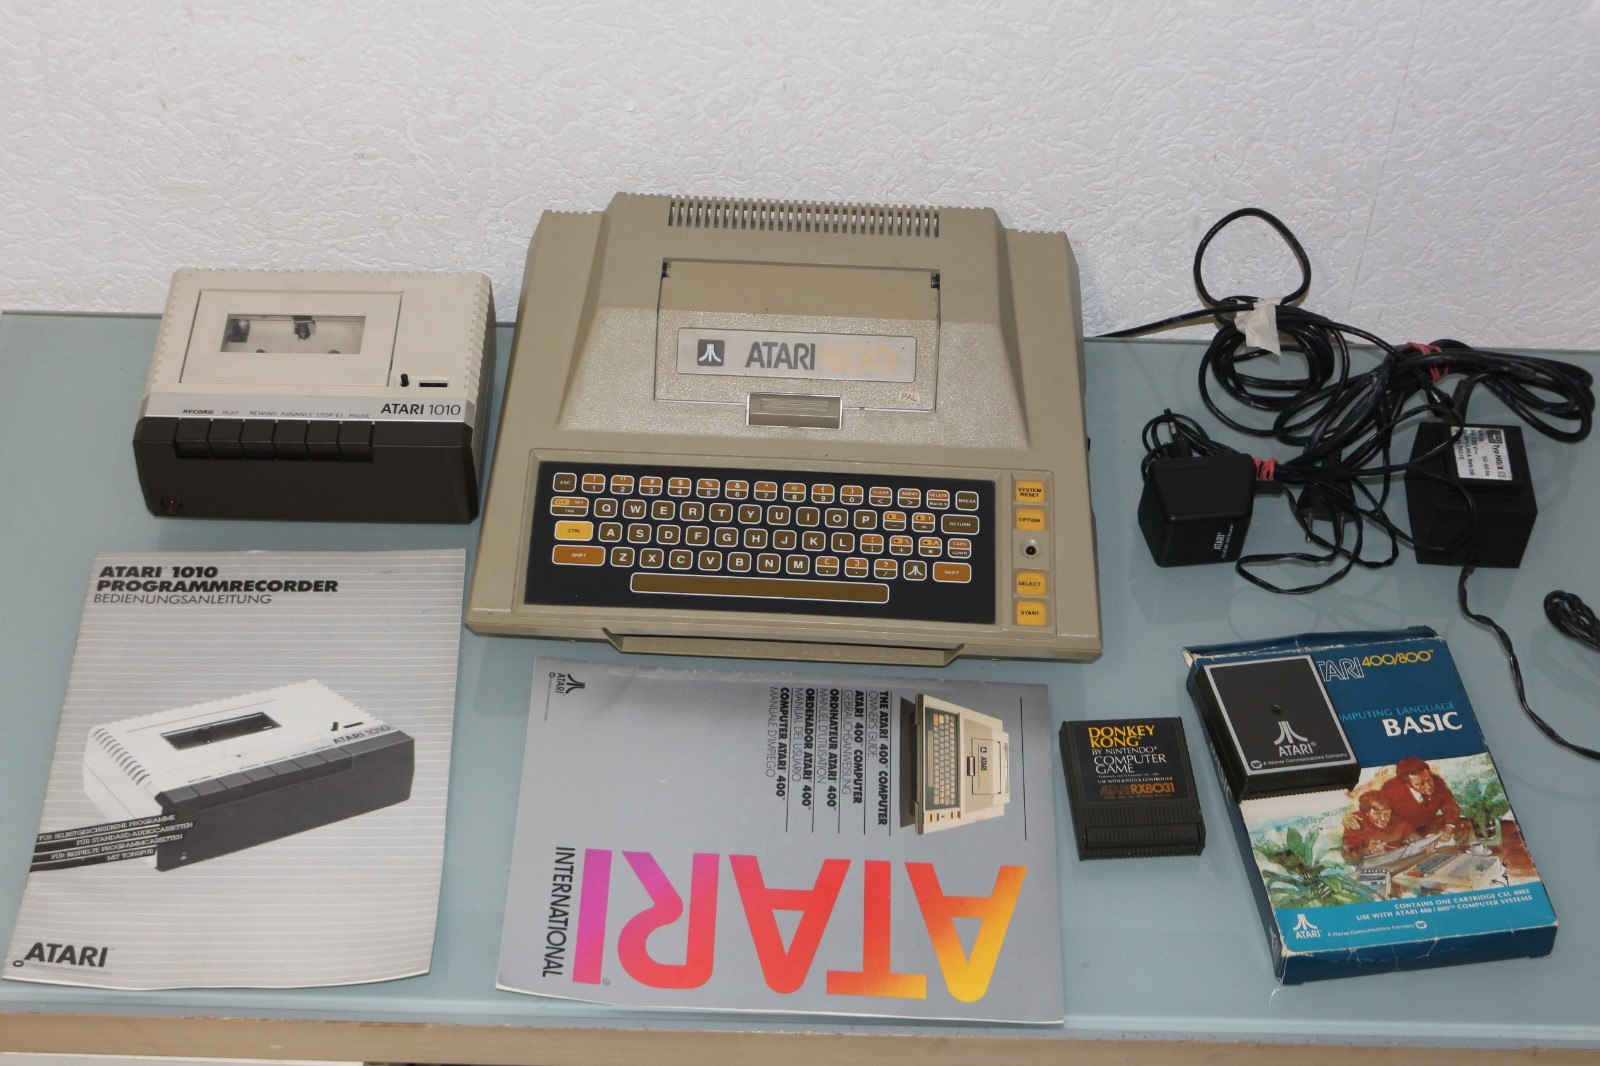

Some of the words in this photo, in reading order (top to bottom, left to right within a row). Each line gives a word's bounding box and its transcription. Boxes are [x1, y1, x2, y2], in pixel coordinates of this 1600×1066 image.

[745, 341, 816, 371] ATARI
[818, 342, 898, 374] 400
[901, 392, 918, 401] PAL
[381, 403, 425, 416] ATARI
[429, 404, 461, 416] 1010
[602, 504, 611, 513] Q
[630, 505, 642, 514] W
[660, 506, 668, 515] E
[688, 507, 697, 516] R
[718, 509, 726, 517] T
[747, 510, 755, 519] Y
[775, 511, 784, 520] U
[832, 514, 842, 523] O
[862, 515, 870, 524] P
[606, 528, 615, 537] A
[635, 529, 644, 538] S
[664, 530, 673, 540] D
[694, 531, 702, 540] F
[722, 533, 732, 542] G
[751, 534, 760, 543] H
[781, 536, 788, 545] J
[809, 537, 818, 546] K
[839, 538, 847, 547] L
[619, 553, 628, 562] Z
[647, 554, 656, 563] X
[676, 555, 686, 564] C
[706, 556, 715, 565] V
[735, 558, 744, 567] B
[765, 559, 774, 568] N
[793, 560, 804, 569] M
[99, 566, 163, 578] ATARI
[172, 566, 219, 578] 1010
[96, 580, 339, 592] PROGRAMMRECORDER
[93, 593, 272, 605] BEDIENUNGSANLEITUNG
[1315, 657, 1365, 682] TARI
[555, 672, 566, 694] ATARI
[768, 687, 779, 727] MANUALE
[794, 687, 804, 724] MANUAL
[819, 688, 829, 722] MANUEL
[855, 690, 864, 717] ATARI
[879, 691, 889, 709] THE
[779, 687, 790, 740] COMPUTER
[1340, 708, 1393, 721] MPUTING
[1396, 701, 1456, 715] LANGUAGE
[804, 688, 815, 749] ORDENADOR
[829, 689, 839, 749] ORDINATEUR
[880, 711, 889, 739] ATARI
[1382, 711, 1463, 737] BASIC
[333, 732, 366, 744] ATARI
[365, 725, 391, 735] 1010
[794, 726, 803, 740] DEL
[854, 722, 864, 743] 400
[1088, 725, 1155, 738] DONKEY
[842, 690, 854, 795] GEBRAUCHSANWEISUNG
[868, 732, 878, 758] GUIDE
[1090, 736, 1139, 748] KONG
[766, 730, 777, 777] D'IMPIEGO
[777, 742, 787, 770] ATARI
[817, 726, 828, 784] D'UTILISATION
[879, 743, 888, 765] 400
[1092, 748, 1102, 756] BY
[1279, 743, 1313, 757] ATARI
[792, 744, 803, 782] USUARIO
[803, 751, 813, 780] ATARI
[828, 752, 838, 780] ATARI
[1094, 754, 1167, 765] COMPUTER
[1095, 764, 1135, 774] GAME
[853, 750, 864, 804] COMPUTER
[776, 775, 786, 797] 400
[802, 785, 812, 806] 400
[827, 785, 837, 807] 400
[878, 771, 888, 825] COMPUTER
[39, 833, 53, 841] FÜR
[54, 822, 128, 839] SELBSTGESCHRIEBENE
[129, 815, 176, 828] PROGRAMME
[51, 851, 65, 860] FÜR
[67, 847, 100, 857] BESPIELTE
[101, 834, 184, 852] PROGRAMMCASSETTEN
[76, 837, 90, 846] FÜR
[107, 853, 121, 861] MIT
[122, 849, 154, 859] TONSPUR
[1395, 899, 1434, 909] CONTAINS
[1453, 893, 1496, 903] CARTRIDGE
[1395, 909, 1418, 917] ATARI
[1457, 900, 1499, 910] COMPUTER
[1500, 895, 1533, 905] SYSTEMS
[542, 847, 576, 978] INTERNATIONAL
[572, 848, 1028, 1003] ATARI
[1296, 930, 1320, 939] ATARI
[24, 942, 108, 967] ATARI
